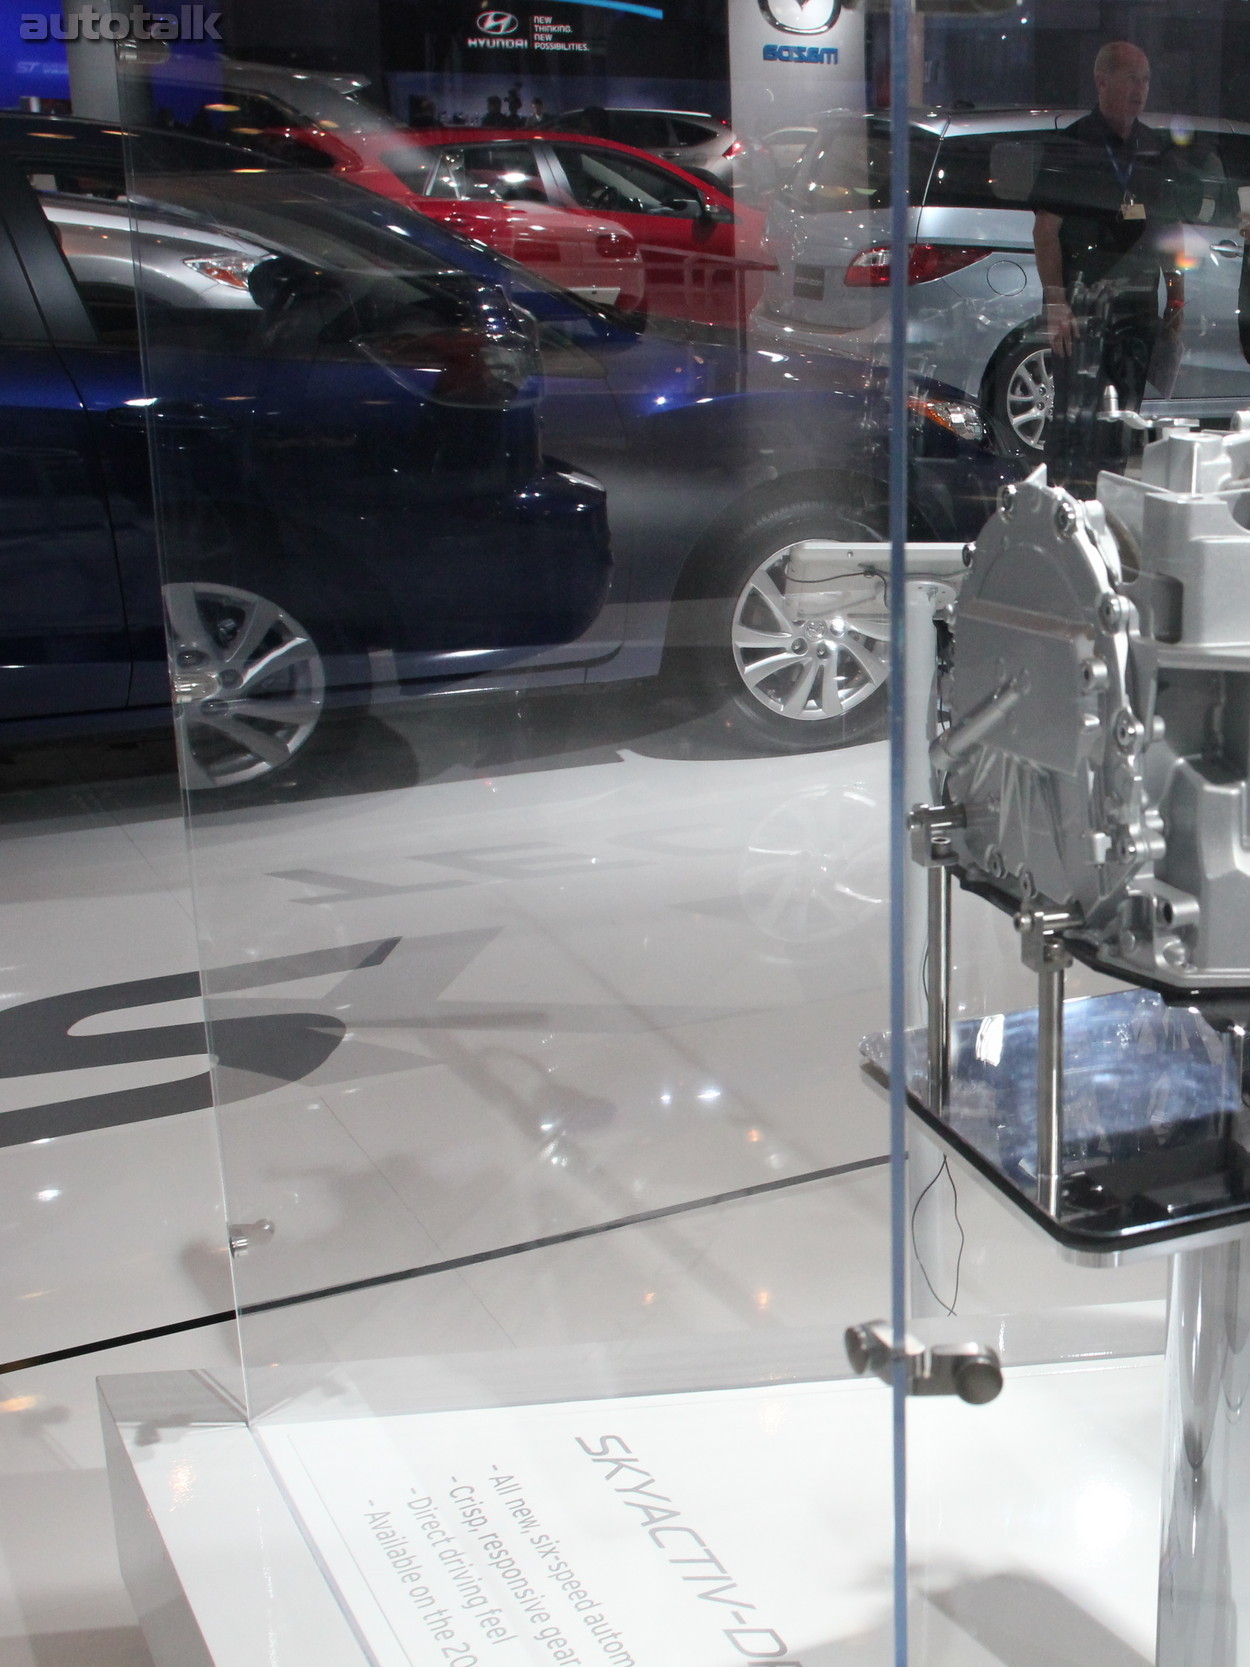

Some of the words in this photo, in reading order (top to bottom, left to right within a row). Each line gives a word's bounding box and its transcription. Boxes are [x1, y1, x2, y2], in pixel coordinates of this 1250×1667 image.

[533, 16, 553, 24] NEW
[534, 25, 573, 33] THINKING.
[467, 38, 529, 49] HYUNDAI
[533, 34, 553, 42] NEW
[534, 42, 591, 52] POSSIBILITIES.
[488, 1475, 523, 1496] All
[505, 1497, 541, 1534] new,
[364, 1510, 423, 1584] Available
[408, 1585, 436, 1609] on
[422, 1608, 455, 1642] the
[406, 1496, 456, 1548] Direct
[438, 1548, 489, 1610] driving
[475, 1608, 518, 1645] feel
[449, 1485, 488, 1533] Crisp,
[478, 1531, 551, 1624] responsive
[533, 1626, 582, 1667] gear
[529, 1533, 603, 1613] six-speed
